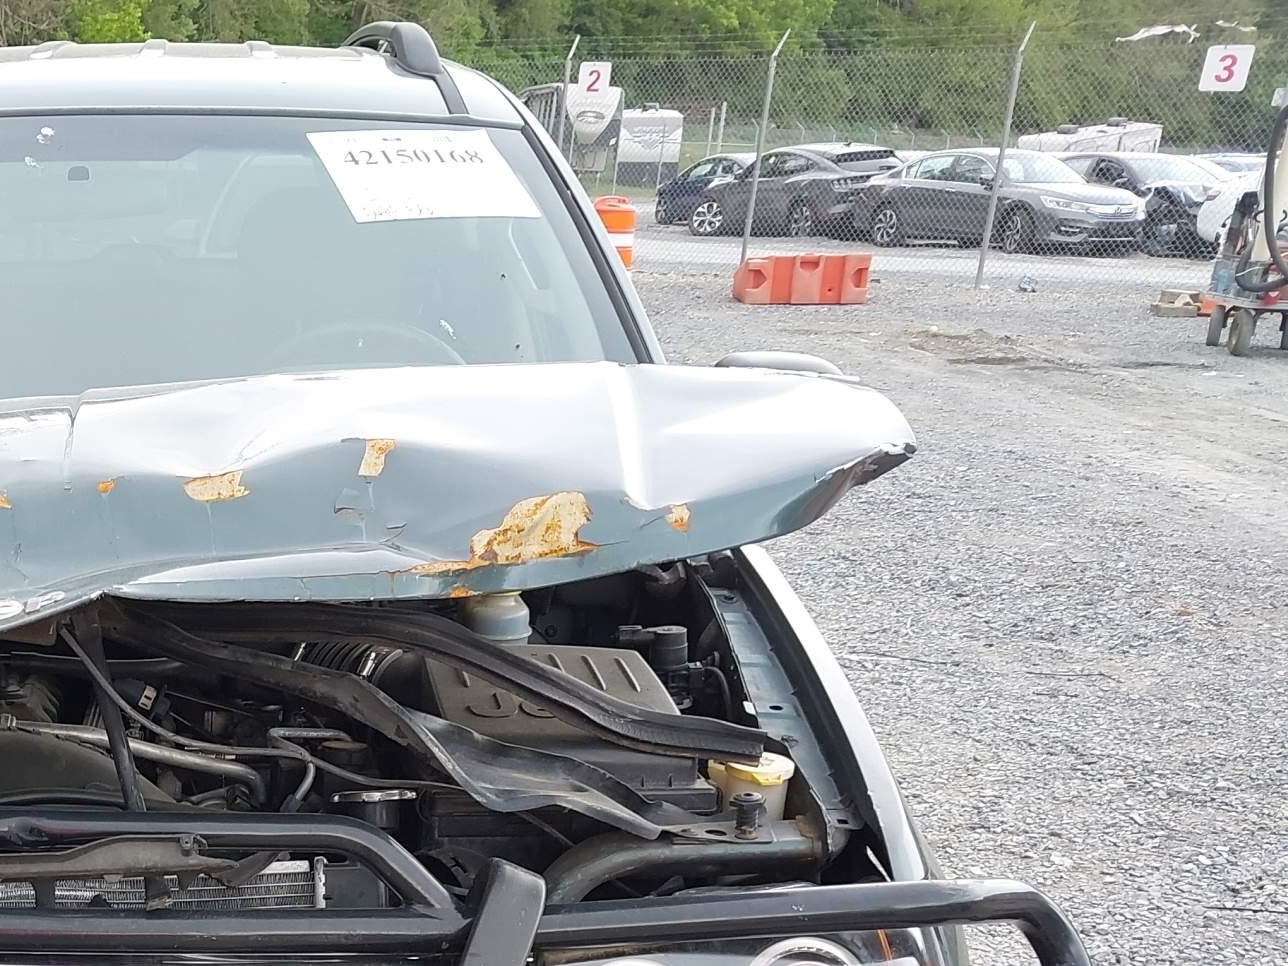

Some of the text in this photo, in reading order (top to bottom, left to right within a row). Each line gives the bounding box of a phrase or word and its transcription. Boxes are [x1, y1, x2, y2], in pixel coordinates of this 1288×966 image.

[1214, 54, 1238, 83] 3
[586, 70, 601, 92] 2
[343, 148, 484, 166] 42150168
